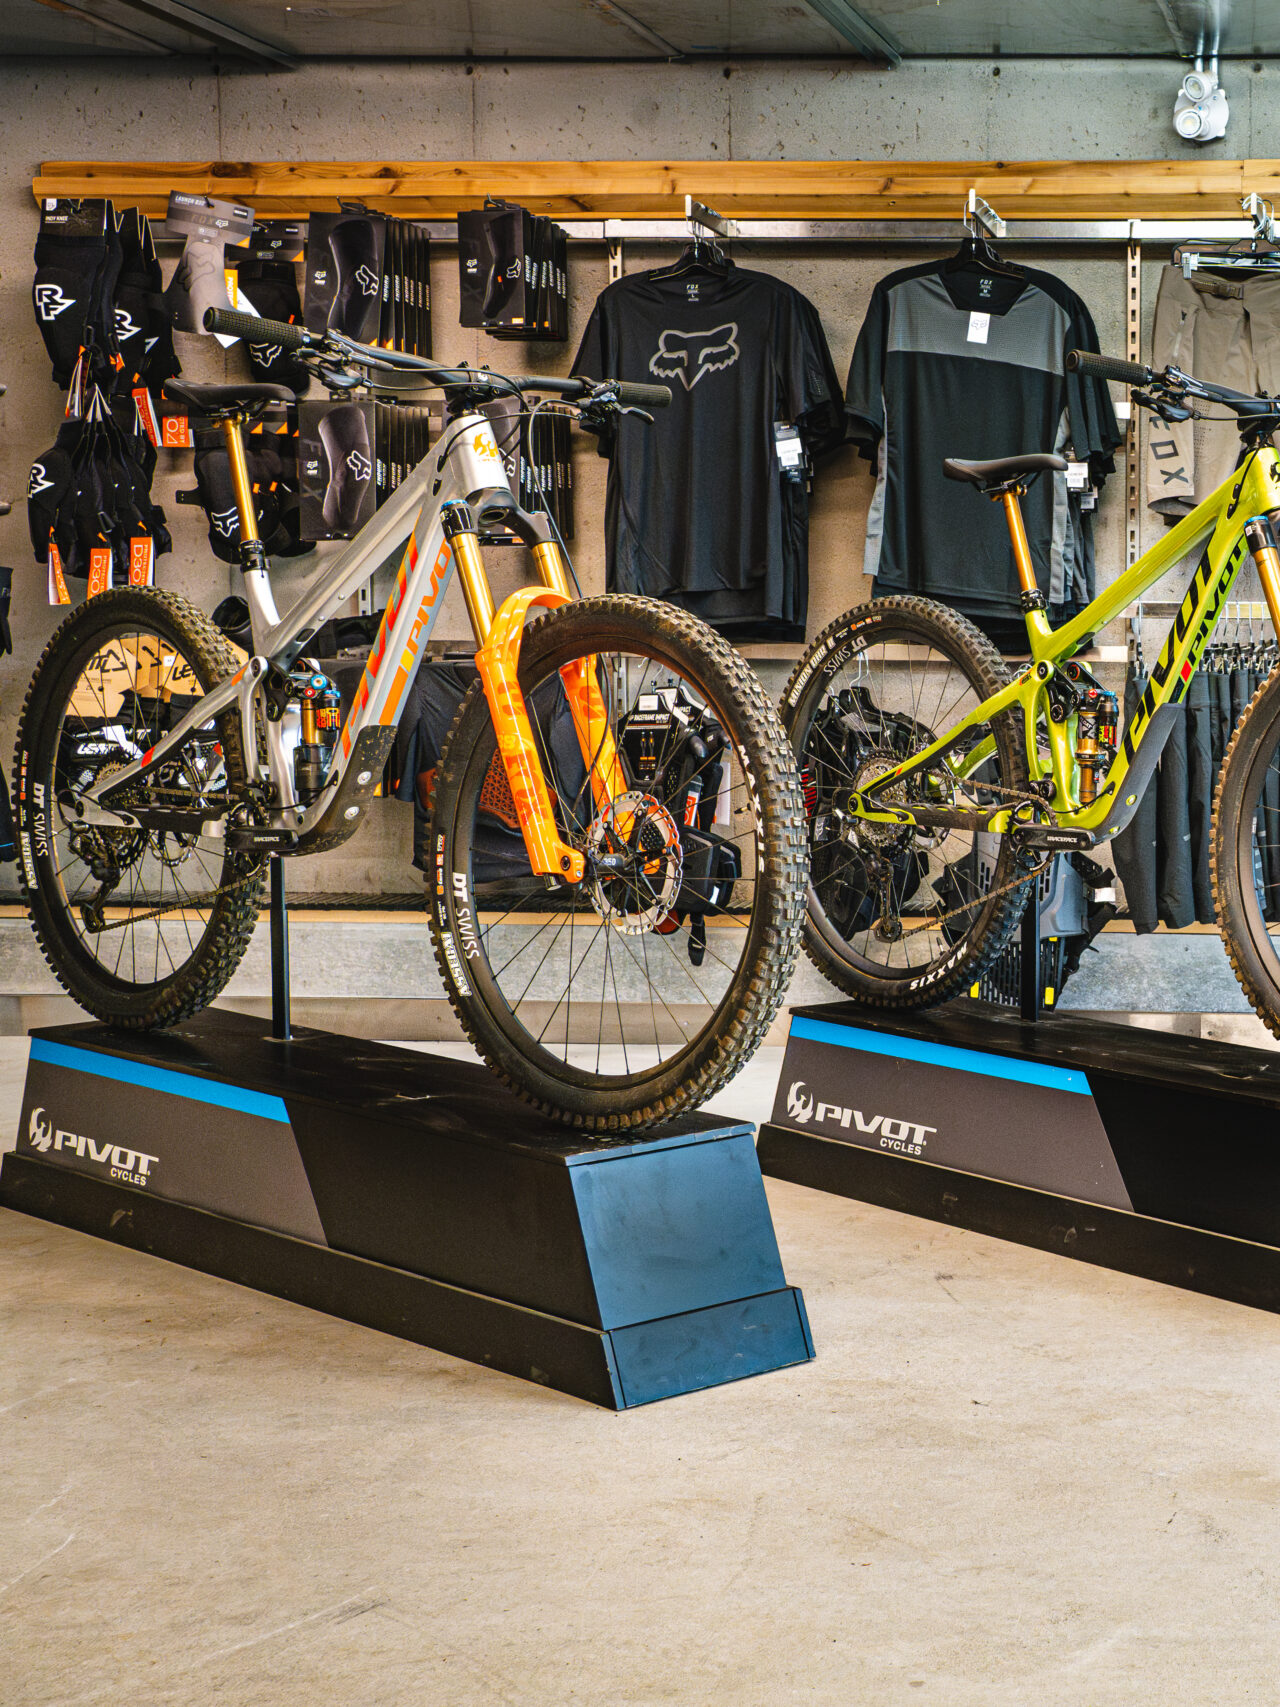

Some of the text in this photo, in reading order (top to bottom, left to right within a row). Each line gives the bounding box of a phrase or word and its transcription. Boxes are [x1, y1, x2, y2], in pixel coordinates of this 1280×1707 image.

[1149, 415, 1189, 485] FOX
[1188, 533, 1251, 667] PIVOT
[823, 635, 868, 677] DT SWISS
[787, 663, 814, 708] MINION
[33, 782, 49, 857] DT SWISS
[453, 872, 480, 959] DT SWISS
[909, 941, 968, 990] MAXXIS
[815, 1102, 938, 1146] PIVOT
[879, 1137, 922, 1156] CYCLES
[54, 1129, 160, 1176] PIVOT
[110, 1167, 147, 1187] CYCLES
